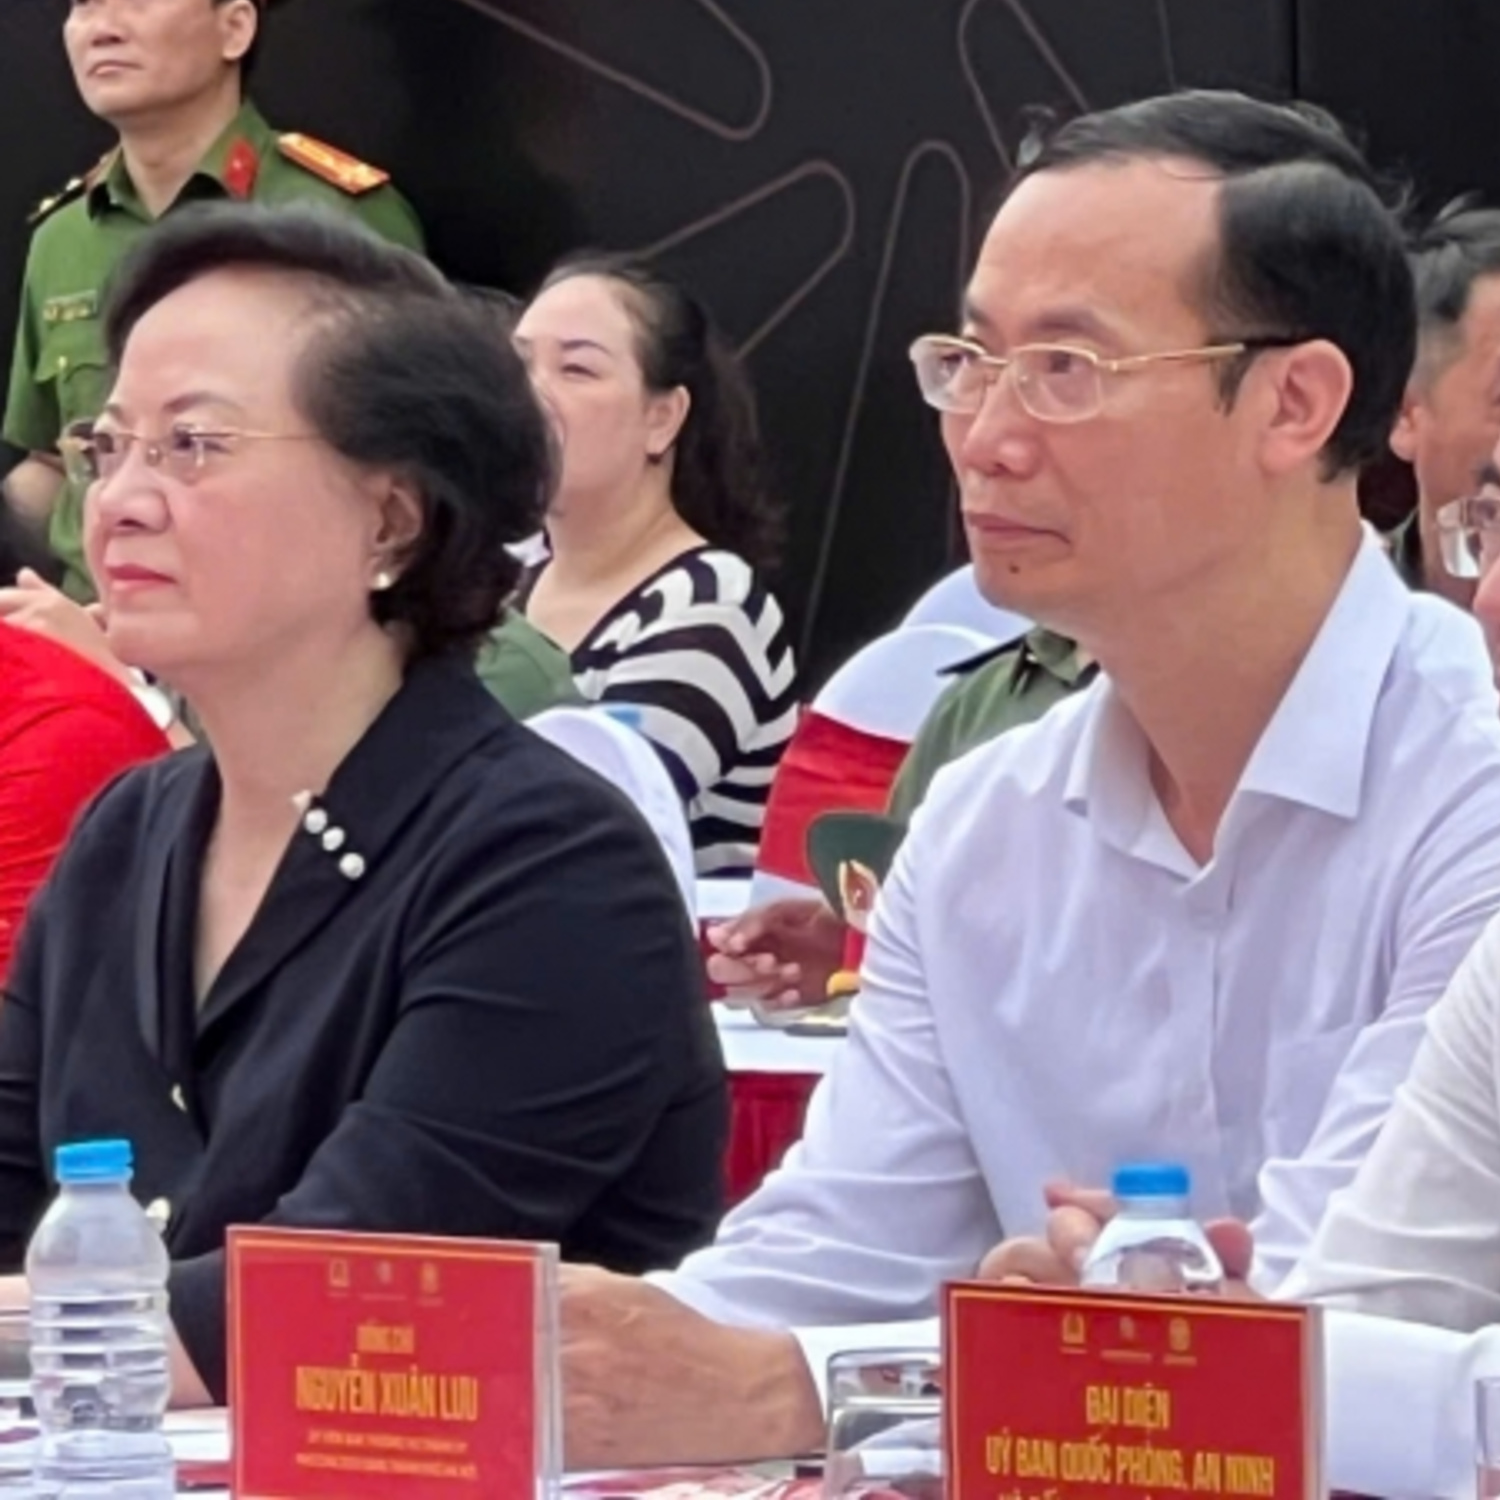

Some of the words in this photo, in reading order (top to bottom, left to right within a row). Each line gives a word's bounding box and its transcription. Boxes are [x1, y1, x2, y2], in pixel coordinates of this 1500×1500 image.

[1015, 1437, 1057, 1478] BAN
[1060, 1430, 1111, 1484] QUỐC
[1192, 1452, 1221, 1493] AN
[1225, 1454, 1275, 1497] NINH
